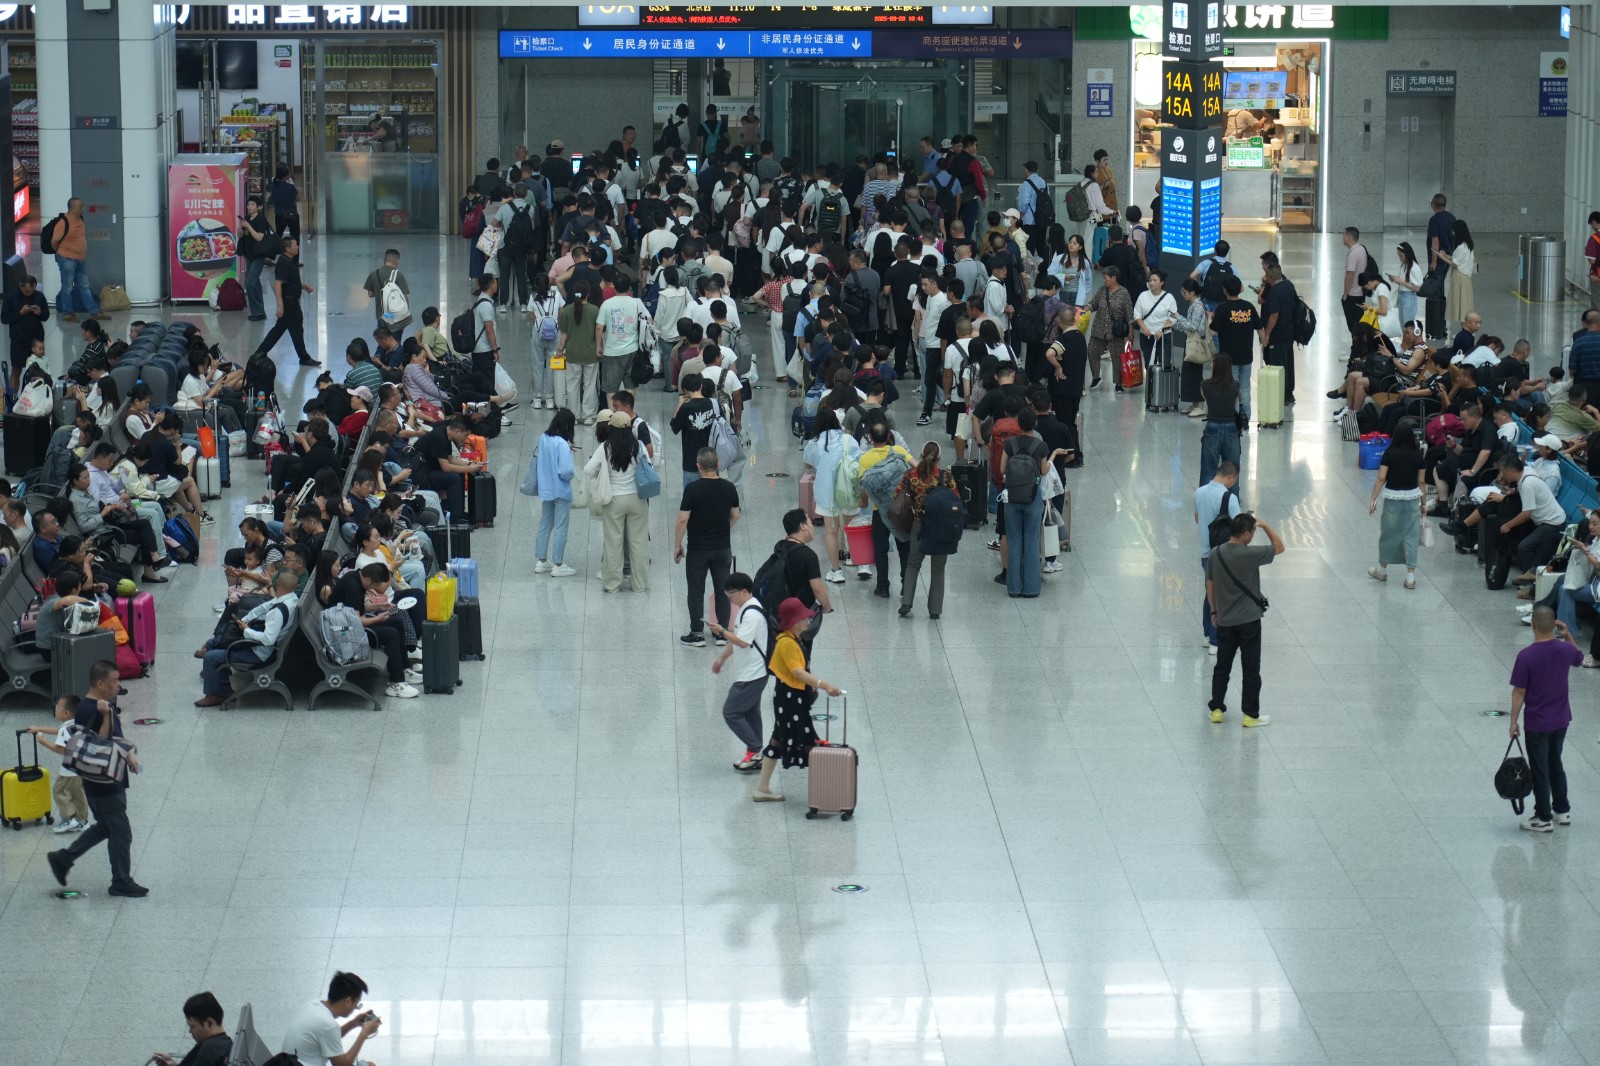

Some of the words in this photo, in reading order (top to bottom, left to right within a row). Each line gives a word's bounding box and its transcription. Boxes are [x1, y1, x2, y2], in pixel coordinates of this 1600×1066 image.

[532, 37, 555, 46] 检票口
[613, 38, 696, 50] 居民身份证通道
[761, 33, 845, 44] 非居民身份证通道
[922, 35, 1007, 46] 商务座便捷检票通道
[1169, 31, 1192, 46] 检票口
[1205, 32, 1221, 46] 检票口
[1166, 71, 1192, 93] 14A
[1203, 71, 1221, 93] 14A
[1409, 75, 1455, 85] 无障碍电梯
[1166, 96, 1192, 118] 15A
[1203, 96, 1220, 117] 15A
[190, 198, 225, 209] 川之味
